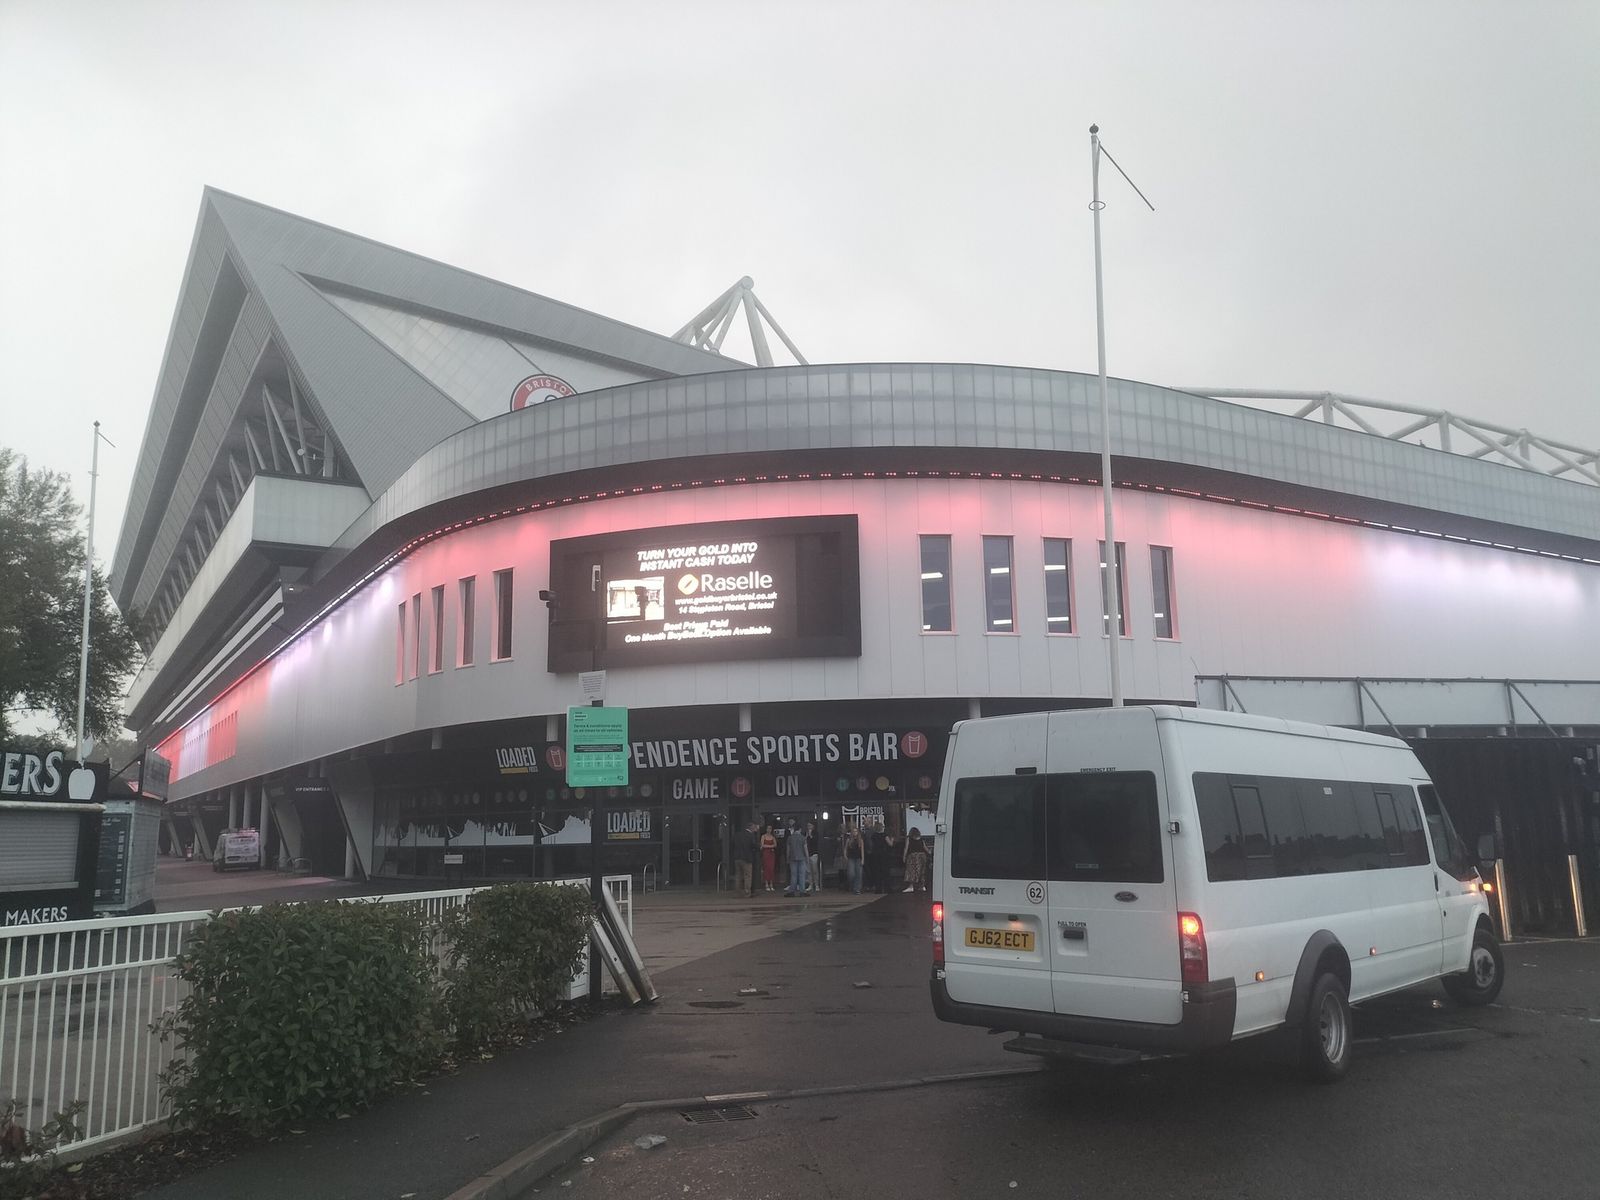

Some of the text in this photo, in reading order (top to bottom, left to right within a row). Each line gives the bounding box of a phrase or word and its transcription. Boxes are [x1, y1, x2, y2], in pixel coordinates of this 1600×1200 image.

[637, 542, 758, 561] TURN YOUR GOLD INTO
[640, 553, 755, 571] INSTANT CASH TODAY
[701, 570, 773, 592] Raselle
[748, 601, 775, 610] Bristol
[624, 634, 641, 643] One
[495, 746, 537, 768] LOADED
[628, 732, 898, 768] ENDENCE SPORTS BAR
[672, 775, 799, 799] GAME ON
[860, 806, 884, 815] BRISTOL
[607, 811, 651, 832] LOADED
[958, 886, 996, 895] TRANSIT
[1029, 887, 1042, 898] 62
[5, 906, 68, 925] MAKERS
[969, 930, 1029, 948] GJ62 ECT
